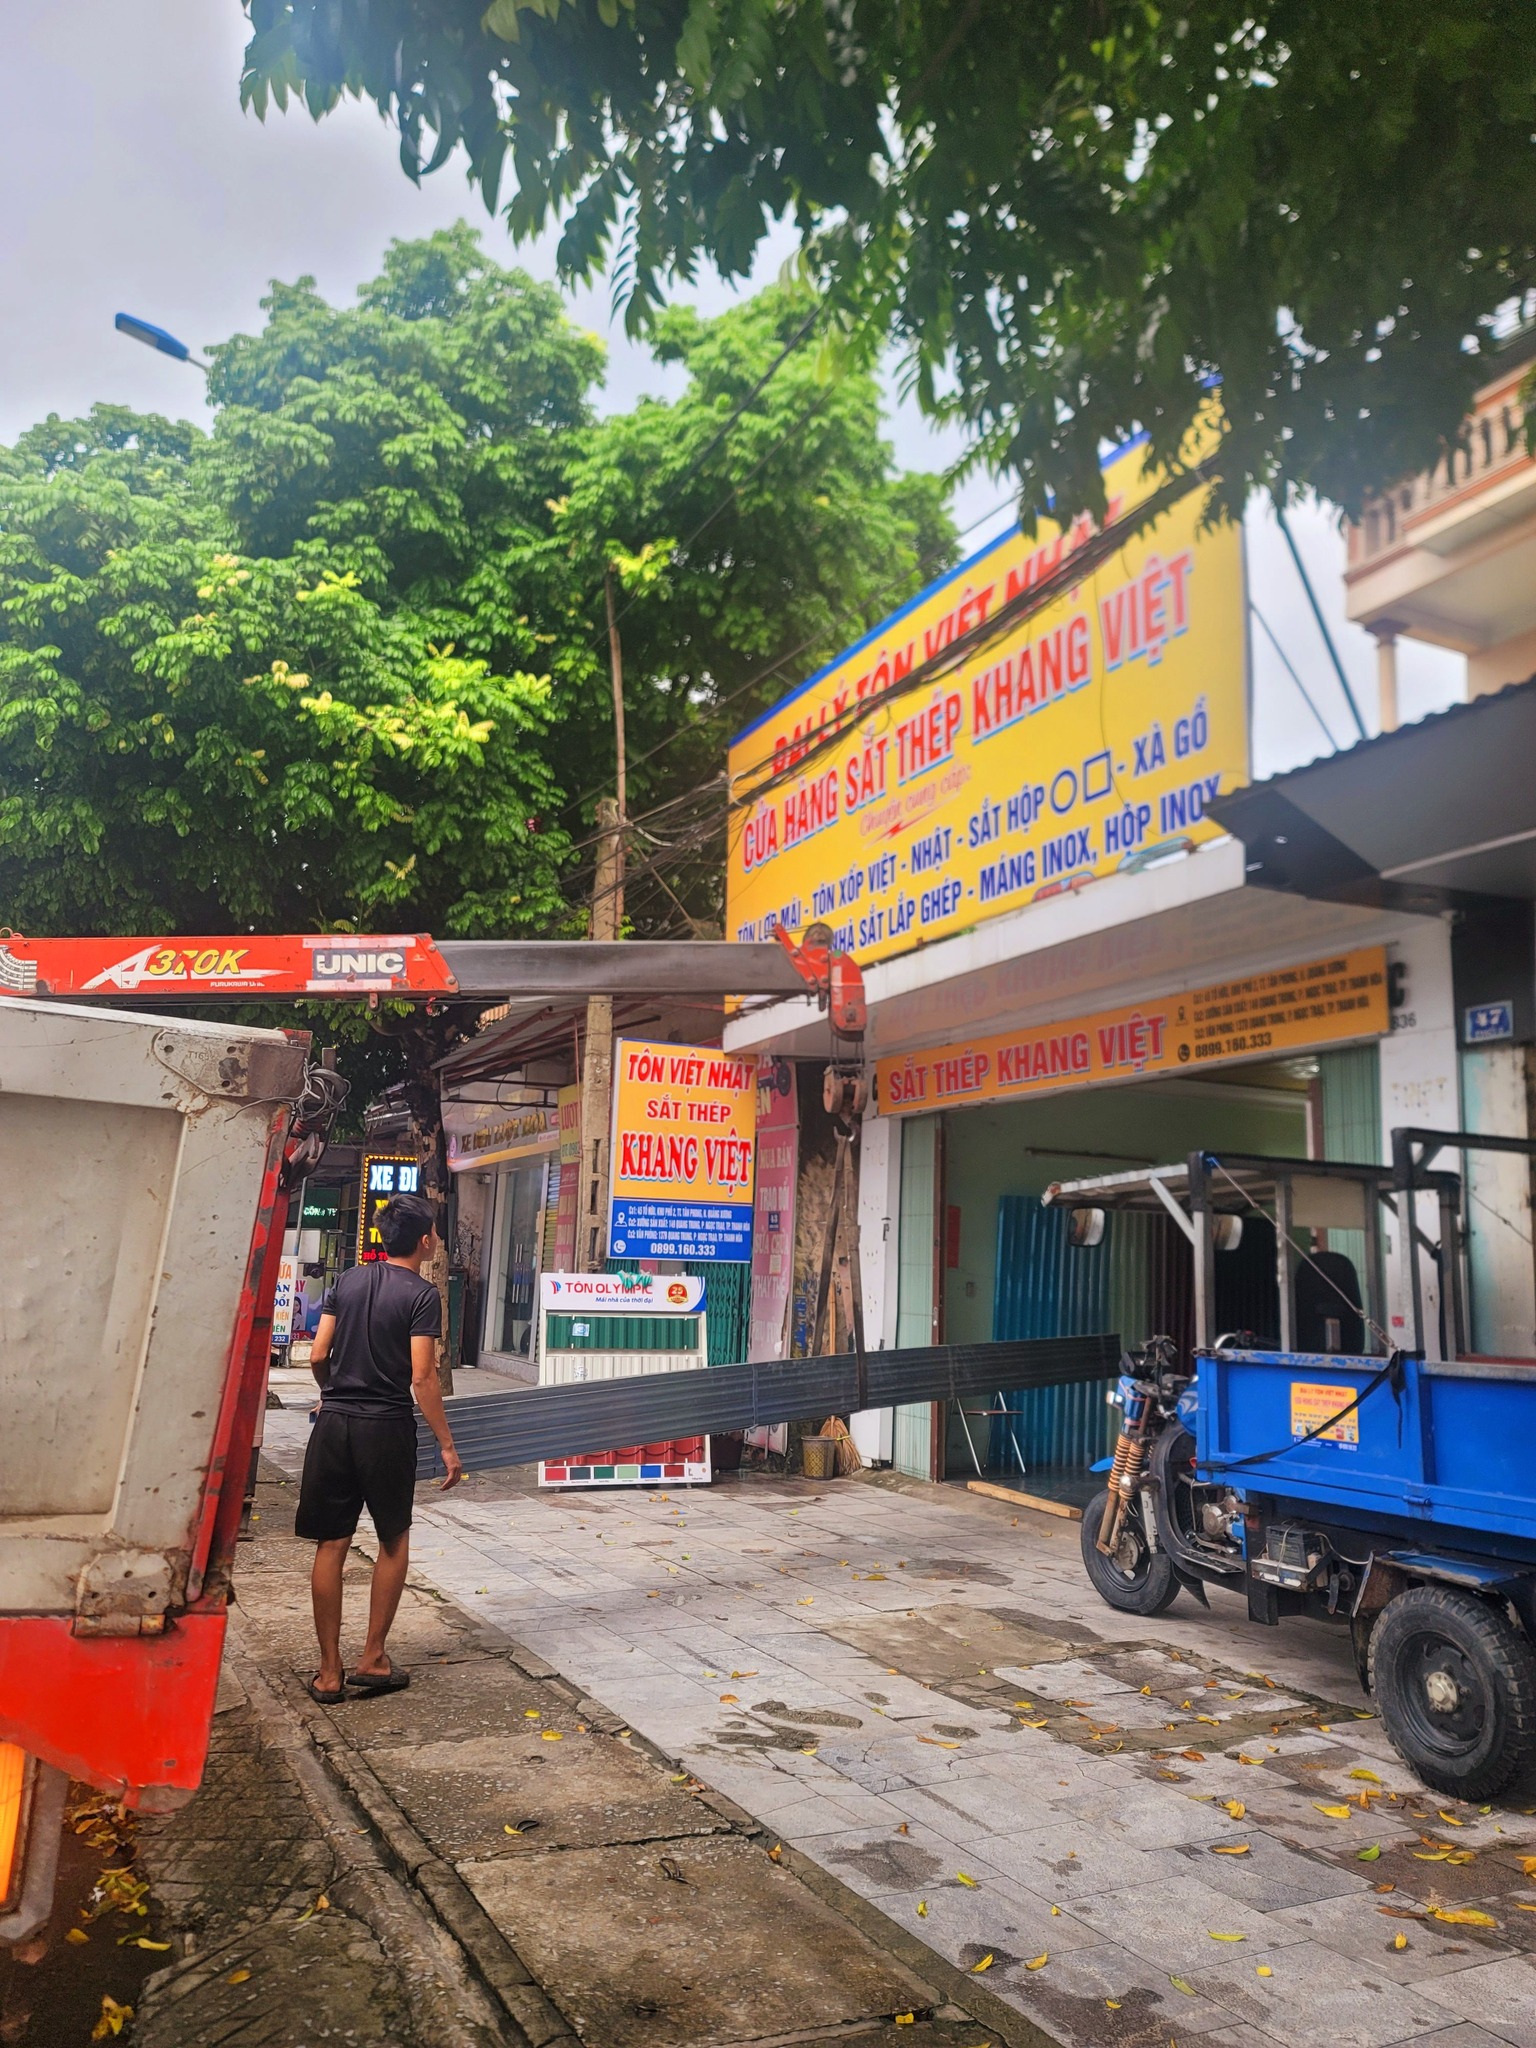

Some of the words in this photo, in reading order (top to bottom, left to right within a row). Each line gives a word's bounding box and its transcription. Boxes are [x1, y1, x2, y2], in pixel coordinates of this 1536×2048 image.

[743, 799, 778, 870] CỬA
[784, 768, 838, 848] HÀNG
[845, 726, 889, 812] SẮT
[973, 616, 1089, 740] KHANG
[1101, 553, 1191, 665] VIỆT
[813, 883, 835, 919] TÔN
[839, 863, 864, 907] XỐP
[868, 852, 896, 895] VIỆT
[911, 828, 952, 874] NHẬT
[968, 798, 1002, 848] SẮT
[1007, 784, 1044, 833] HỘP
[1133, 723, 1166, 777] XÀ
[859, 903, 884, 948] SẮT
[888, 892, 915, 937] LẮP
[920, 874, 962, 925] GHÉP
[1042, 826, 1097, 880] INOX,
[1104, 800, 1151, 857] HỘP
[315, 952, 405, 975] UNIC
[628, 1048, 665, 1083] TÔN
[670, 1052, 706, 1094] VIỆT
[707, 1056, 755, 1098] NHẬT
[889, 1055, 929, 1103] SẮT
[997, 1032, 1090, 1086] KHANG
[1098, 1011, 1167, 1072] VIỆT
[647, 1094, 682, 1120] SẮT
[687, 1101, 732, 1123] THÉP
[369, 1165, 394, 1191] XE
[620, 1132, 698, 1181] KHANG
[705, 1127, 752, 1195] VIỆT
[650, 1242, 716, 1256] 0899.160.333
[565, 1280, 593, 1294] TÔN
[595, 1283, 653, 1295] OLYMPIC
[619, 1296, 631, 1304] của
[631, 1296, 643, 1304] thời
